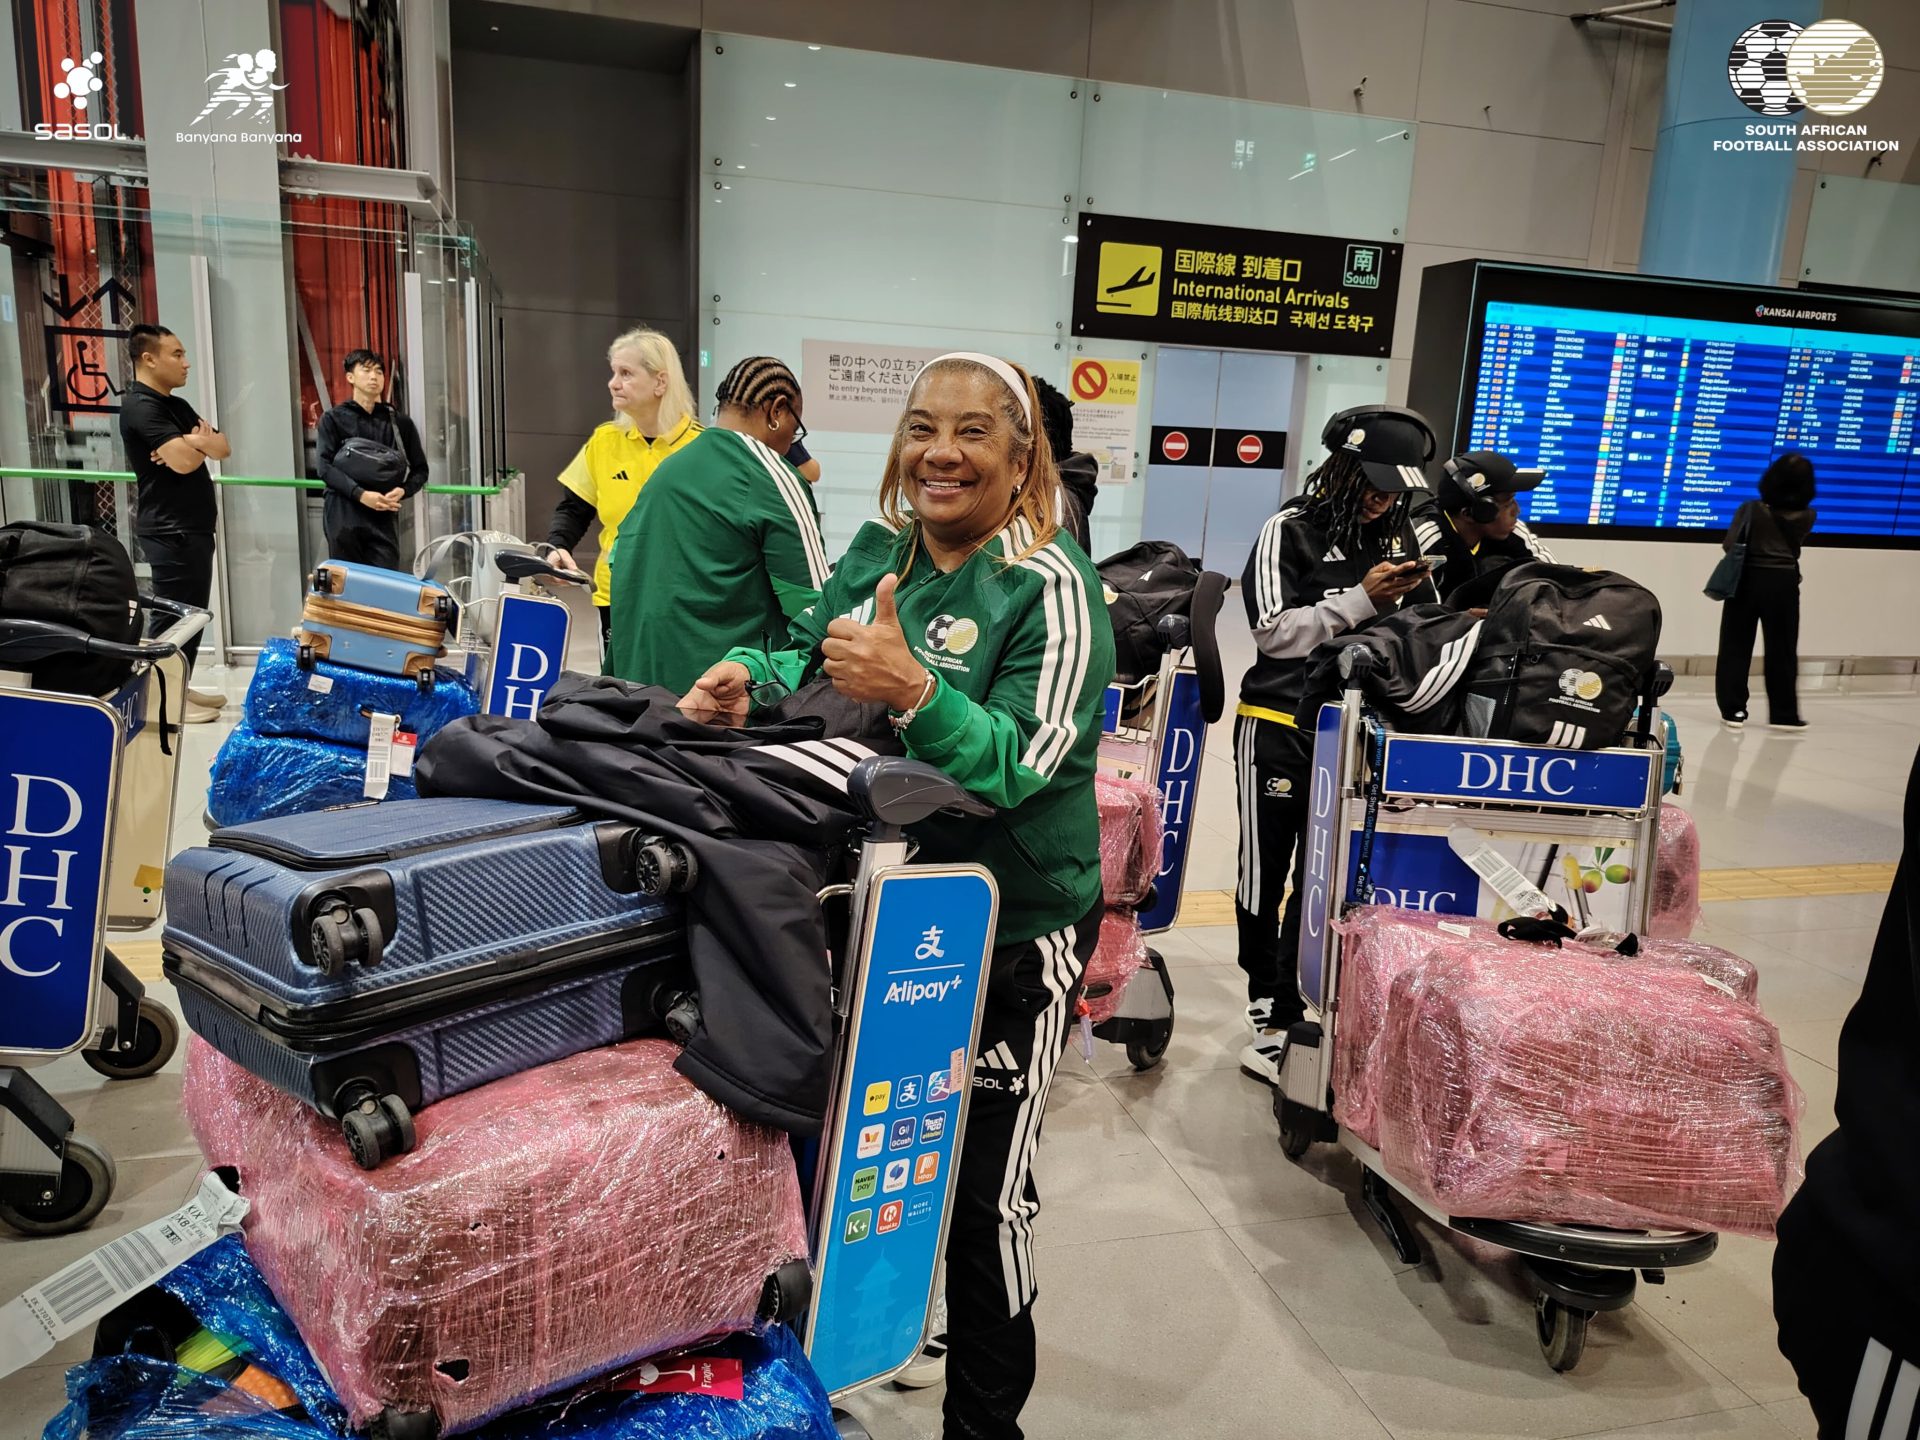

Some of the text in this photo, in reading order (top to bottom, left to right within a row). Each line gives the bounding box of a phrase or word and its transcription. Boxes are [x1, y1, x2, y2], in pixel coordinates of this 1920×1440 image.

[1174, 249, 1302, 282] 国際線 到着口
[1353, 249, 1374, 272] 南
[1345, 271, 1378, 287] South
[1172, 278, 1349, 310] International Arrivals
[1289, 310, 1374, 333] 국제선 도착구
[1763, 307, 1837, 322] KANSAI AIRPORTS
[1119, 387, 1136, 397] Entry
[1457, 751, 1576, 796] DHC
[1307, 766, 1332, 938] DHC
[0, 773, 83, 978] DHC
[891, 1137, 912, 1147] GCash
[855, 1174, 875, 1185] NAVER
[857, 1183, 871, 1193] pay
[186, 1204, 205, 1220] KIX
[847, 1219, 867, 1235] K+
[701, 1363, 714, 1388] Fragile
